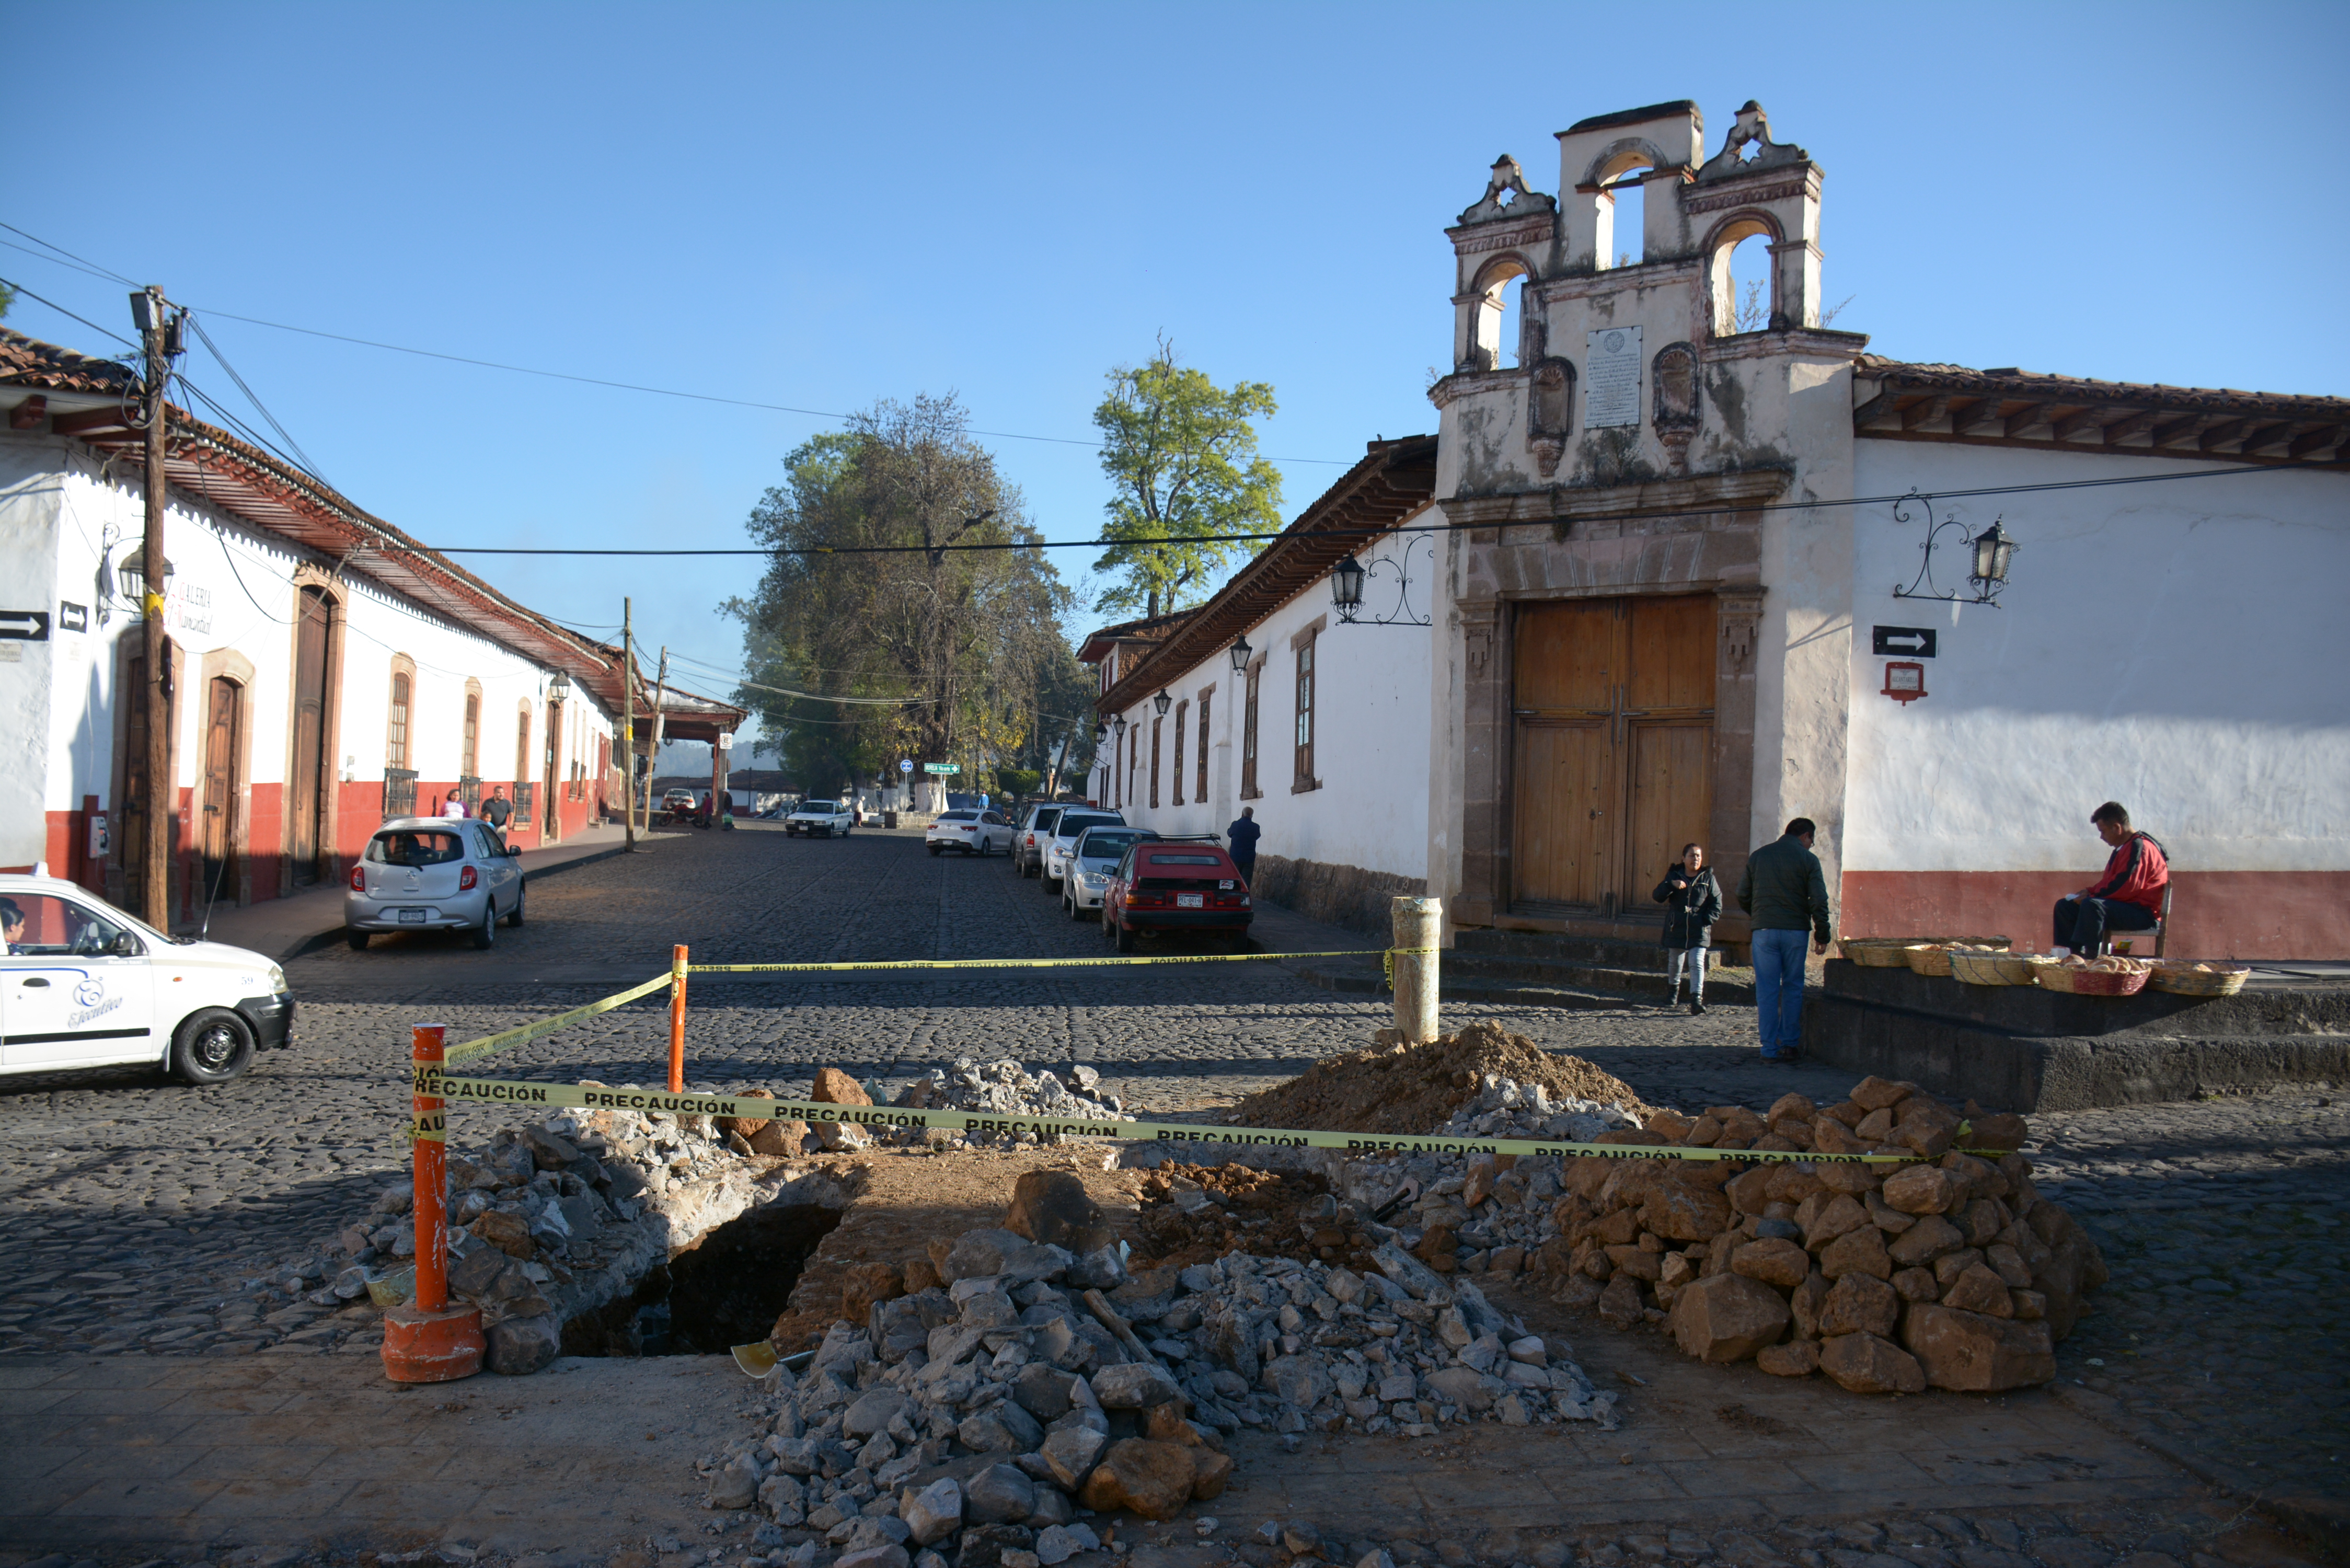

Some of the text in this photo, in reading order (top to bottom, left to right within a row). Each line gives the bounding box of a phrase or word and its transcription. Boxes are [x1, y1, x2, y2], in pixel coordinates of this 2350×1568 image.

[180, 582, 210, 608] GALERIA
[241, 977, 253, 985] 59
[414, 1078, 546, 1102] RECAUCIÓN
[584, 1092, 736, 1115] PRECAUCIÓN
[775, 1106, 926, 1127] PRECAUCIÓN
